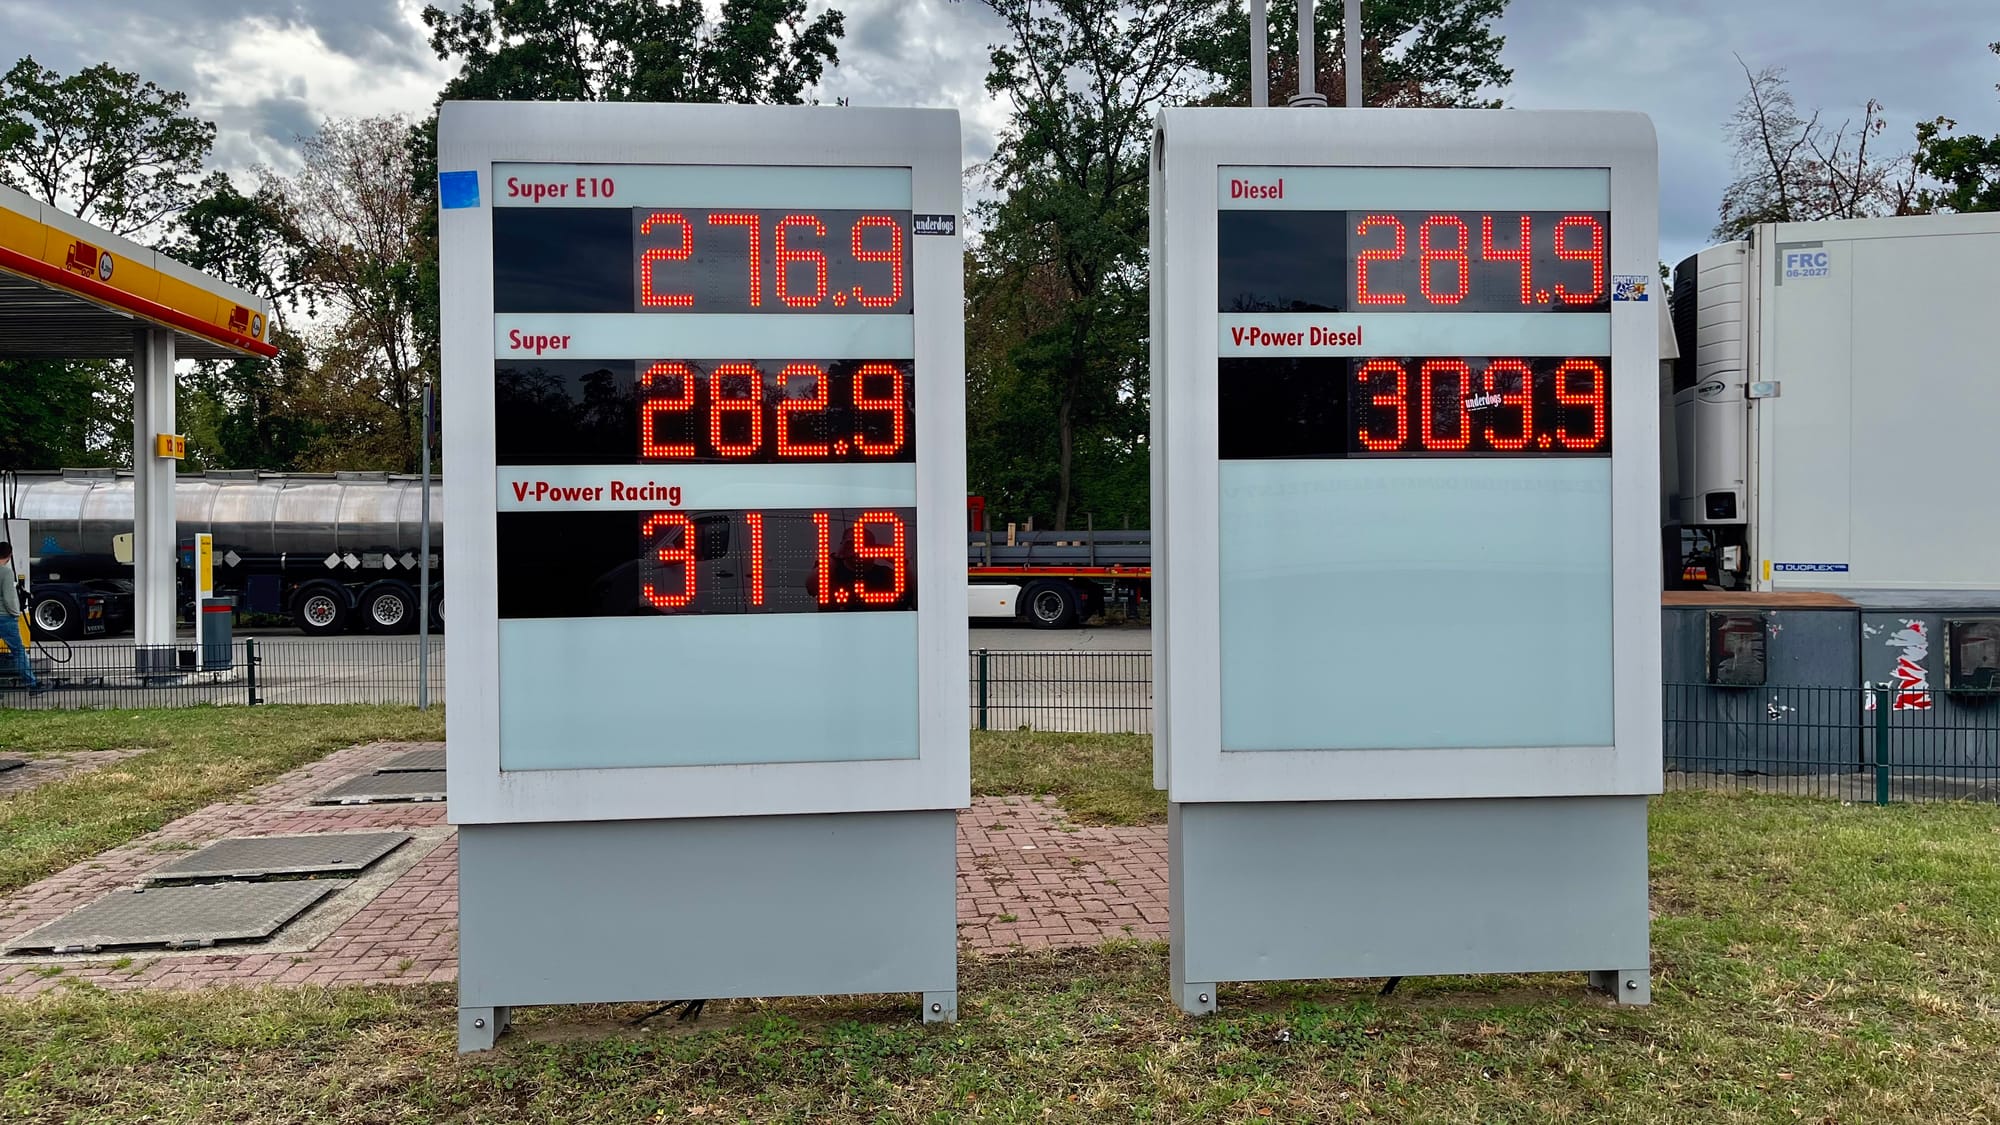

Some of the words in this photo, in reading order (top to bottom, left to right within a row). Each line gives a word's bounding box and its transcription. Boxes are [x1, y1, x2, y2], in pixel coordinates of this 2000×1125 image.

[507, 177, 569, 203] Super
[576, 178, 615, 198] E10
[1230, 179, 1284, 199] Diesel
[915, 216, 954, 235] underdogs
[640, 212, 904, 308] 276.9
[1357, 214, 1605, 305] 284.9
[1787, 252, 1828, 268] FRC
[1786, 268, 1828, 278] 06-2027
[509, 329, 571, 354] Super
[1231, 326, 1304, 346] V-Power
[1309, 326, 1363, 346] Diesel
[641, 363, 905, 458] 282.9
[1465, 391, 1502, 408] underdogs
[512, 481, 604, 502] V-Power
[610, 480, 683, 507] Racing
[642, 511, 906, 608] 311.9
